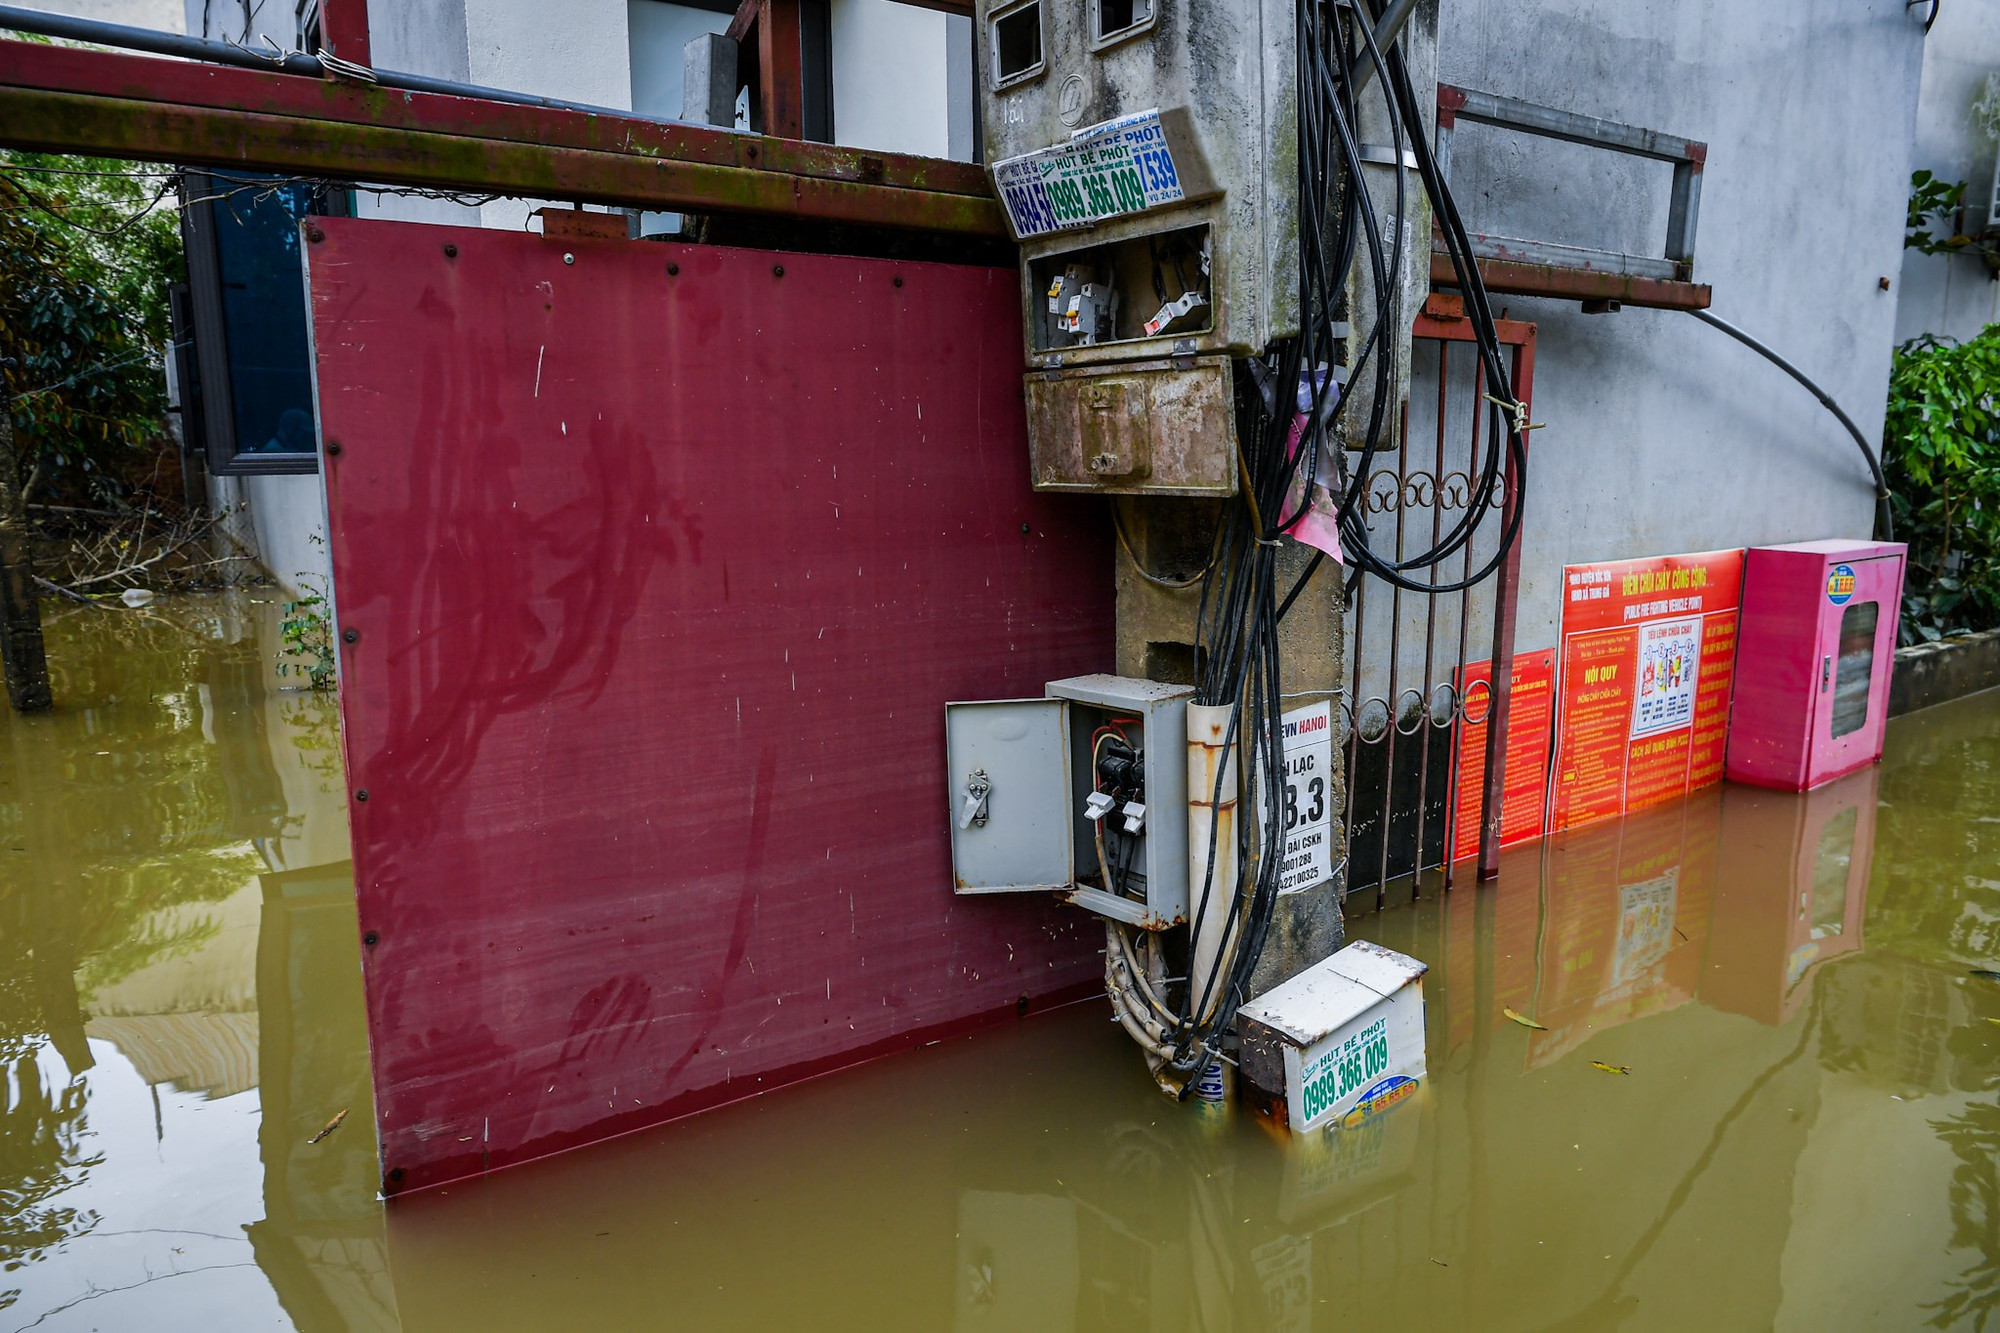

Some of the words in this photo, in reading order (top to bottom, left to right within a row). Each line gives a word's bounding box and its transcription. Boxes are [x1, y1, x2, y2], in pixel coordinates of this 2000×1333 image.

[1124, 124, 1161, 143] PHỐT
[1055, 154, 1077, 170] HÚT
[1099, 144, 1130, 162] PHỐT
[1046, 168, 1146, 221] 0989.366.009
[1161, 189, 1182, 200] 24/24
[1655, 566, 1671, 592] CHÁY
[1672, 565, 1690, 590] CÔNG
[1511, 675, 1521, 684] UY
[1584, 665, 1598, 686] NỘI
[1600, 664, 1618, 682] QUY
[1299, 715, 1327, 734] HANOI
[1293, 754, 1314, 776] LẠC
[1265, 777, 1324, 831] B.3
[1287, 838, 1300, 855] ĐÀI
[1302, 832, 1322, 849] CSKH
[1281, 852, 1312, 873] 9001288
[1277, 866, 1319, 891] 422100325
[1320, 1046, 1341, 1067] HÚT
[1360, 1016, 1386, 1041] PHỐT
[1303, 1036, 1388, 1121] 0989.366.009
